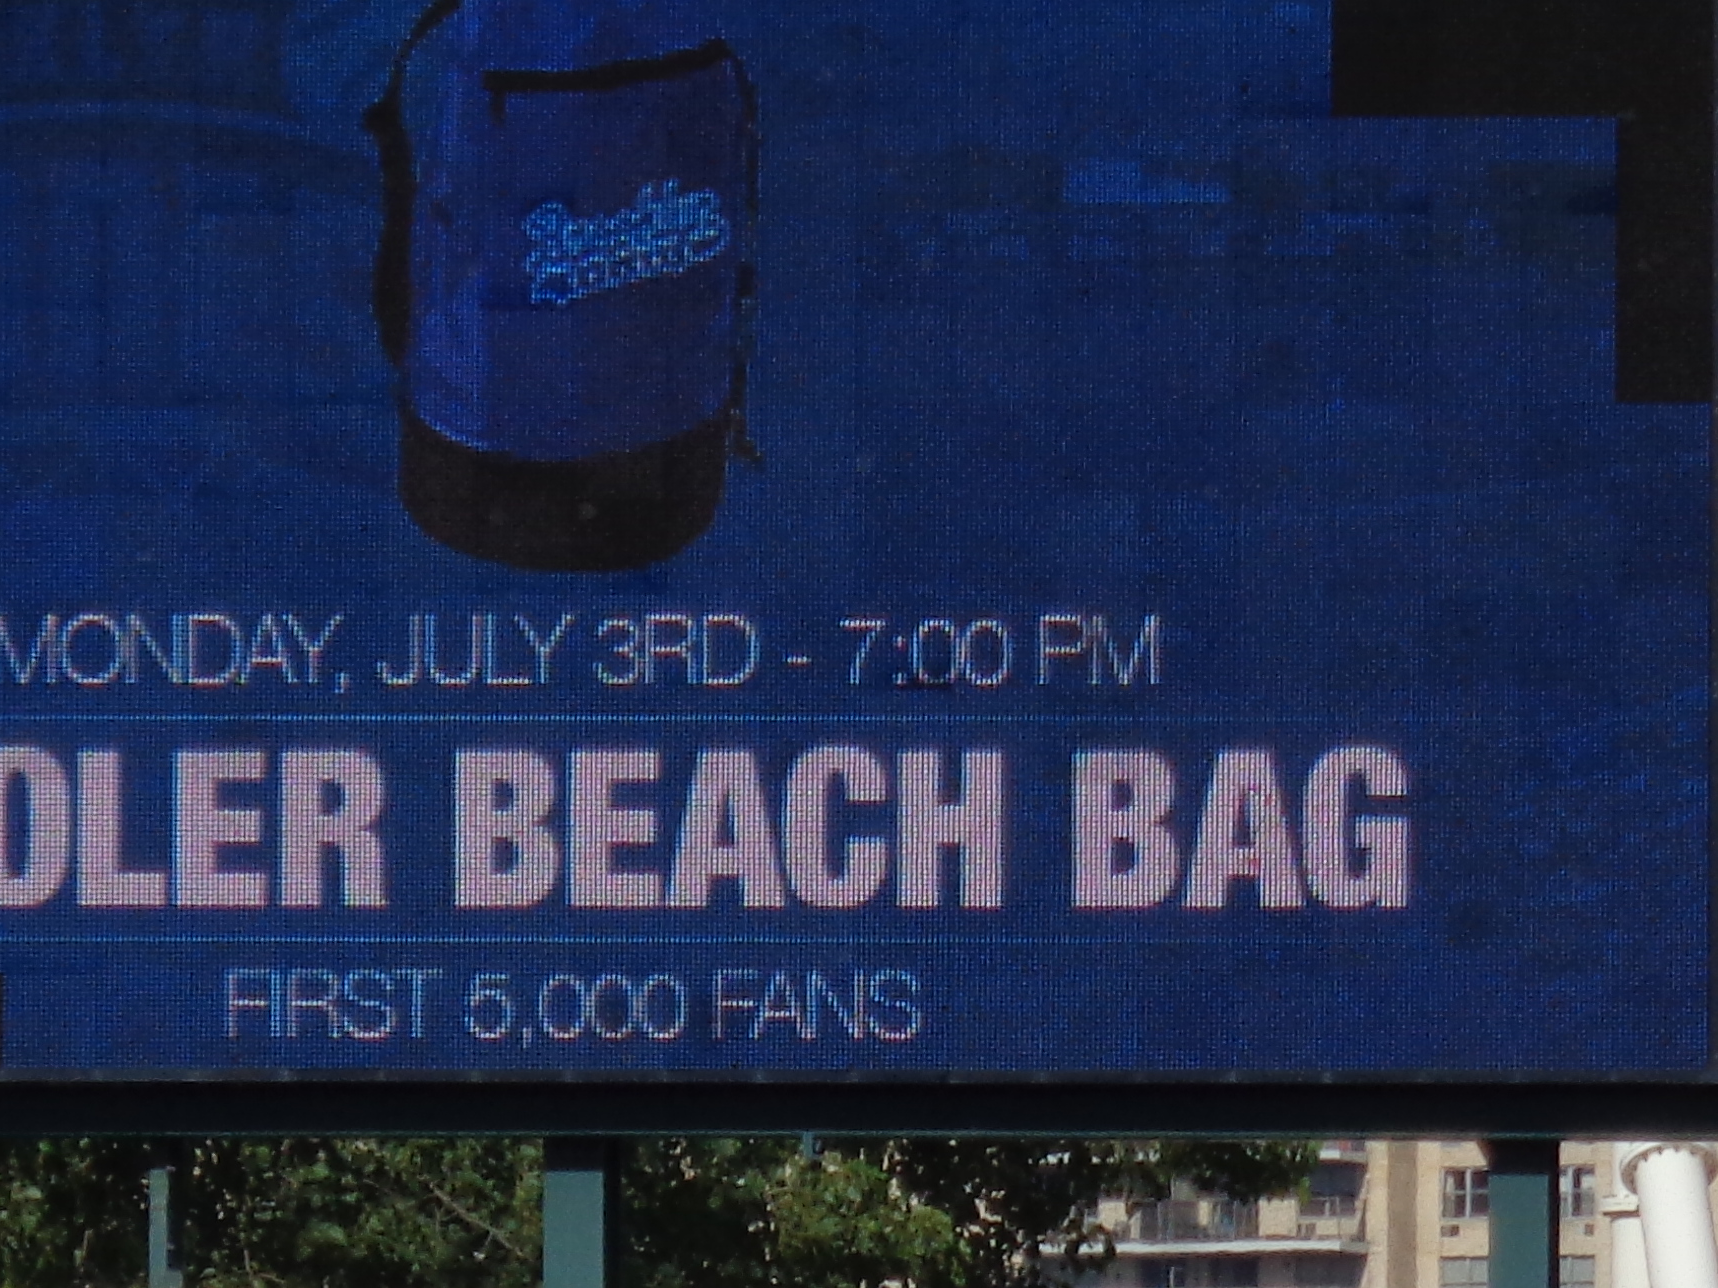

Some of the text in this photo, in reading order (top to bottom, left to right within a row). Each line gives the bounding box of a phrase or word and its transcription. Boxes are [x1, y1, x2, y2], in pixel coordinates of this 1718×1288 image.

[377, 613, 576, 685] JULY
[595, 612, 760, 686] 3RD
[839, 613, 1010, 686] 7:00
[1038, 613, 1164, 686] PM
[452, 744, 1005, 909] BEACH
[1069, 744, 1410, 909] BAG
[225, 967, 923, 1046] FIRST 5,000 FANS
